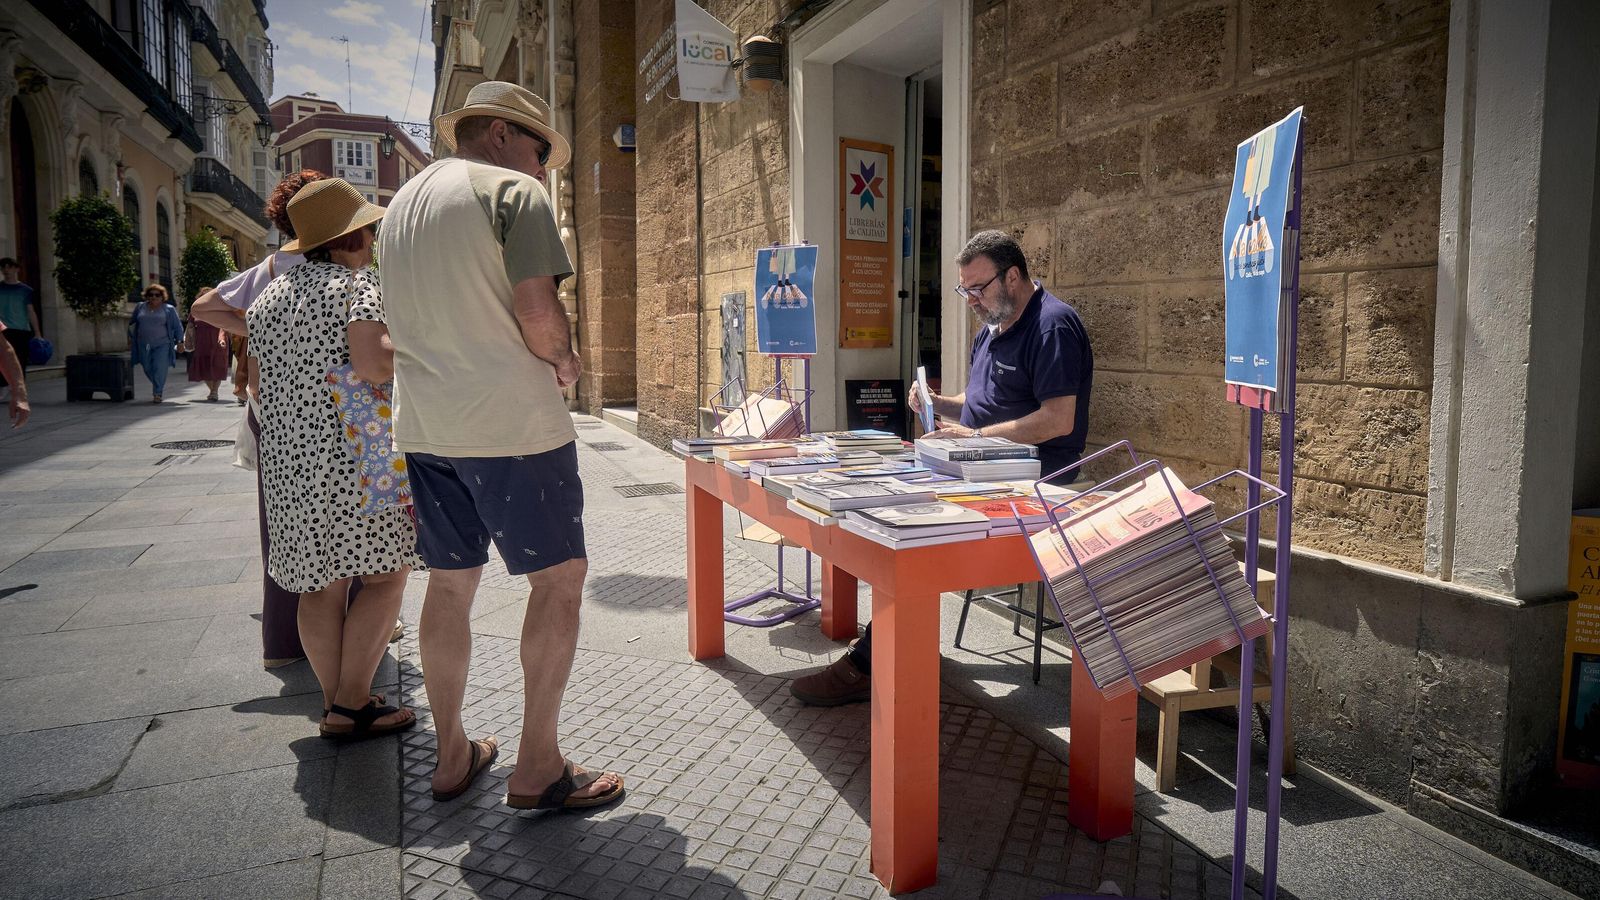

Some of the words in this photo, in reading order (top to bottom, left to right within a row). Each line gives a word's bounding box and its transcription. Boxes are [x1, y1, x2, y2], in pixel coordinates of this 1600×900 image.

[849, 217, 885, 228] LIBRERÍAS
[849, 227, 856, 235] de
[857, 228, 885, 238] CALIDAD
